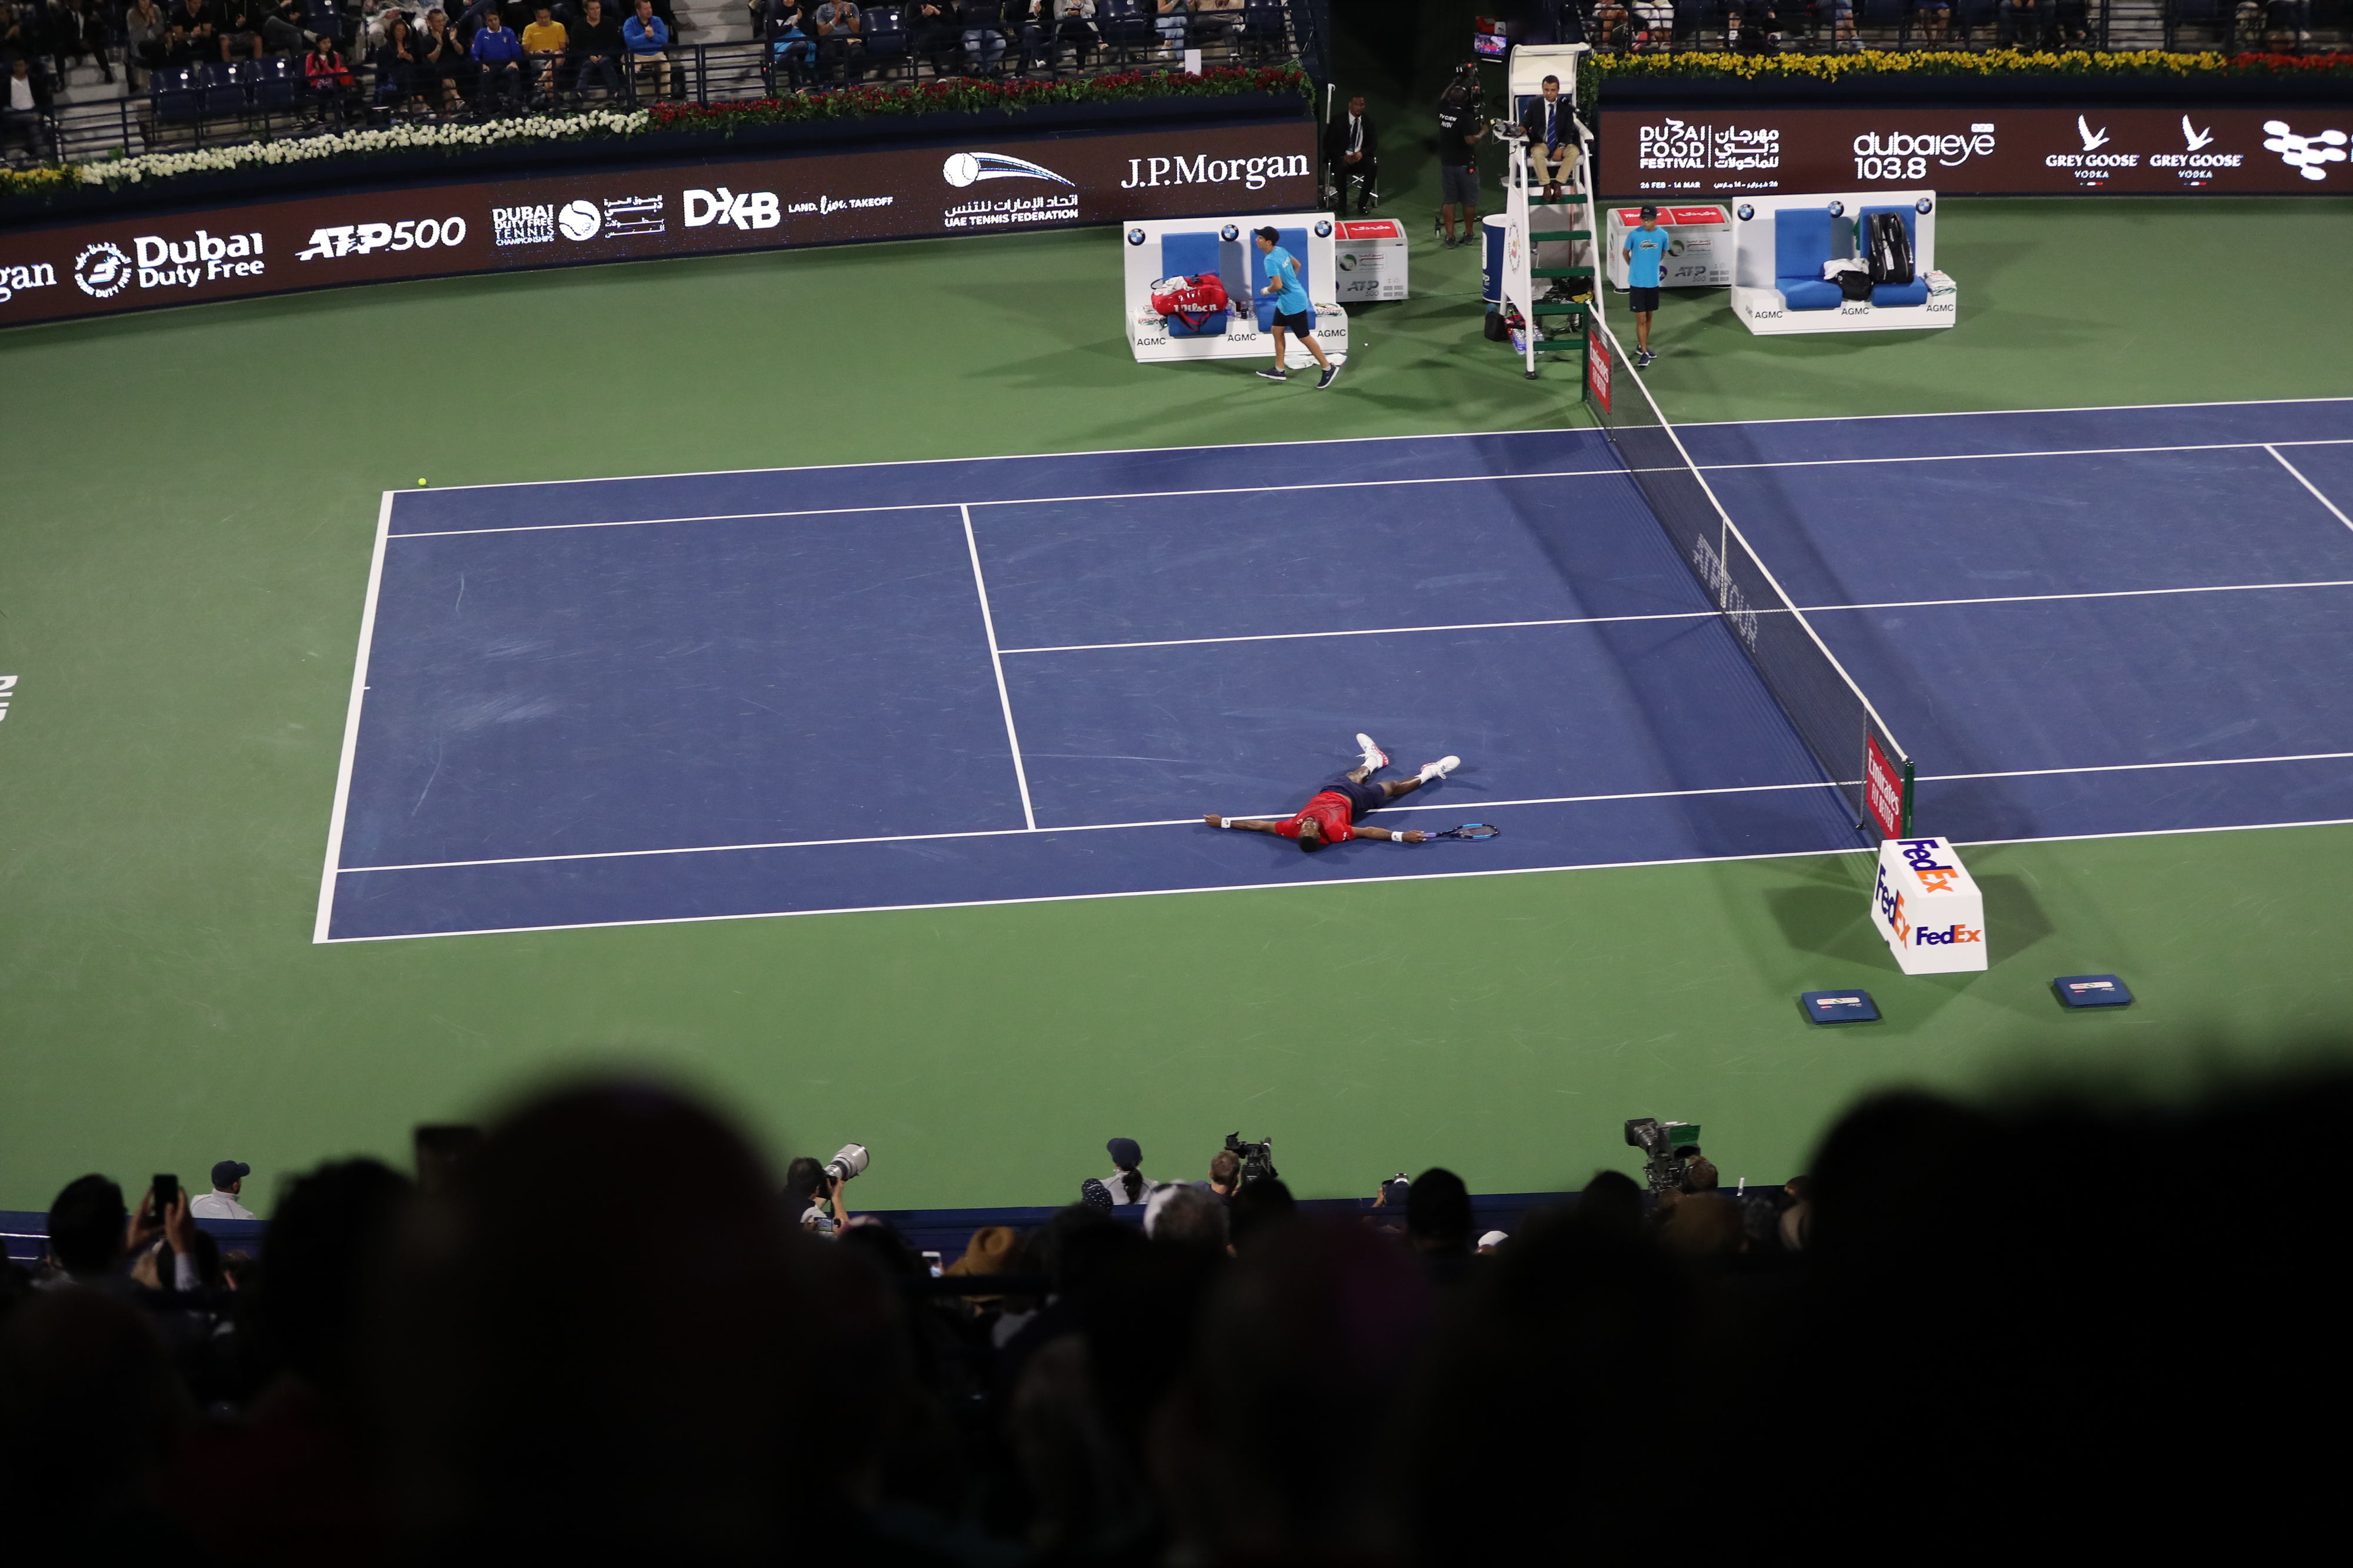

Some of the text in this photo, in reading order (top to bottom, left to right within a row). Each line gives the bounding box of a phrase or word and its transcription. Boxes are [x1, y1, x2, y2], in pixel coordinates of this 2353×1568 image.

[1715, 122, 1779, 145] مهرجان
[1641, 141, 1705, 158] FOOD
[1715, 142, 1779, 158] دبي
[1640, 158, 1705, 169] FESTIVAL
[1715, 152, 1779, 171] للمأكولات
[1855, 157, 1927, 179] 103.8
[2045, 154, 2139, 167] GREY GOOSE
[2149, 154, 2244, 167] GREY GOOSE
[1121, 154, 1310, 190] J.P.Morgan
[2074, 170, 2109, 179] VODKA
[2178, 170, 2213, 179] VODKA
[683, 187, 781, 230] DXB
[788, 203, 818, 213] LAND.
[849, 196, 894, 208] TAKEOFF
[945, 201, 992, 217] للتنس
[1046, 194, 1079, 208] اتحاد
[492, 204, 554, 222] DUBAI
[945, 209, 1079, 227] UAE TENNIS FEDERATION
[495, 217, 554, 230] DUTY FREE
[495, 225, 555, 239] TENNIS
[134, 230, 264, 268] Dubai
[137, 259, 265, 288] Duty Free
[1675, 266, 1706, 277] ATP
[95, 284, 119, 298] DUTY
[1347, 281, 1379, 292] ATP
[1755, 311, 1783, 319] AGMC
[1841, 307, 1870, 316] AGMC
[1926, 303, 1955, 312] AGMC
[1136, 337, 1166, 346] AGMC
[1227, 333, 1257, 342] AGMC
[1317, 329, 1347, 338] AGMC
[1868, 747, 1899, 816] Emirates
[1879, 795, 1894, 833] BETTER
[1896, 839, 1959, 893] FedEx
[1875, 862, 1911, 950] FedEx
[1916, 924, 1982, 946] FedEx
